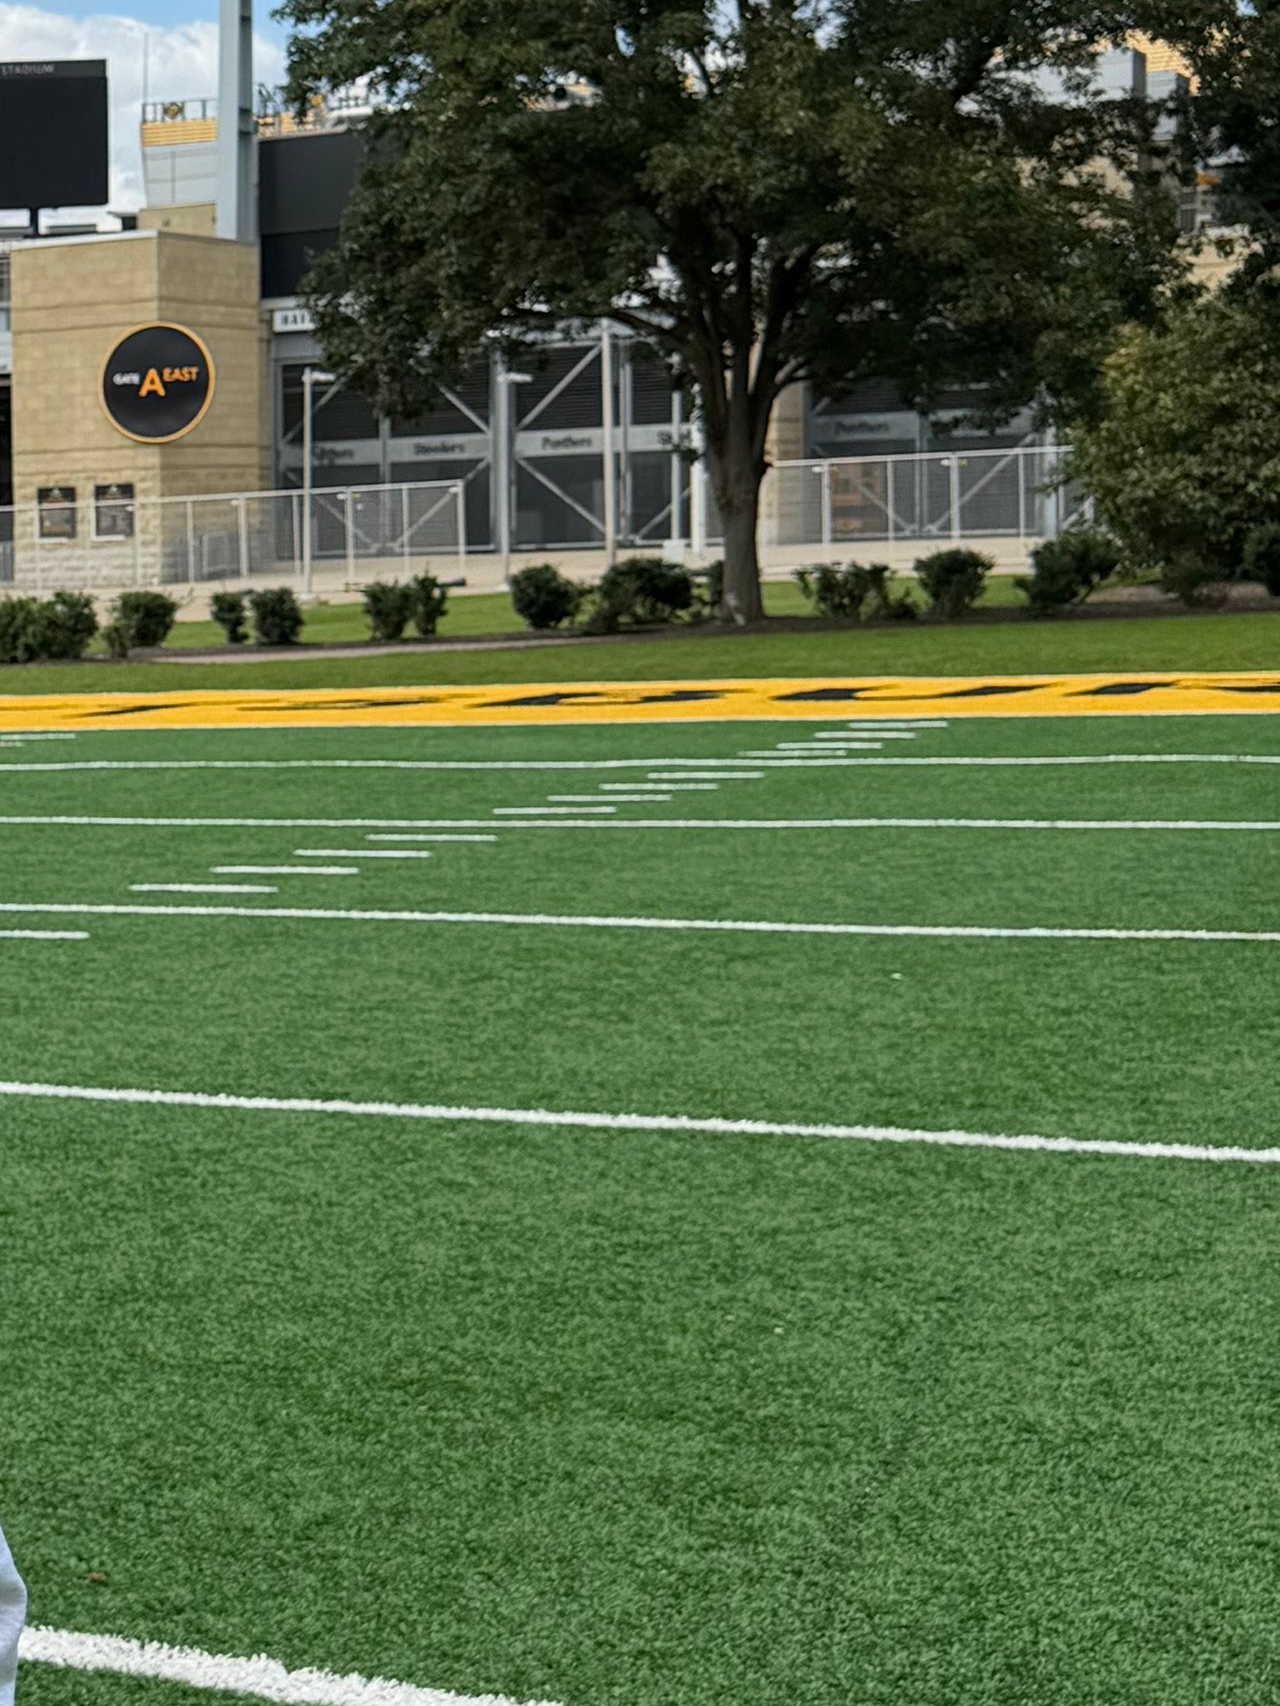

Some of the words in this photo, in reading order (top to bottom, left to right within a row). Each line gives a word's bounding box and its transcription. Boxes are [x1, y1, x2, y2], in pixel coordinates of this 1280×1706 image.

[113, 373, 140, 385] GATE
[138, 368, 166, 397] A
[163, 366, 199, 382] EAST
